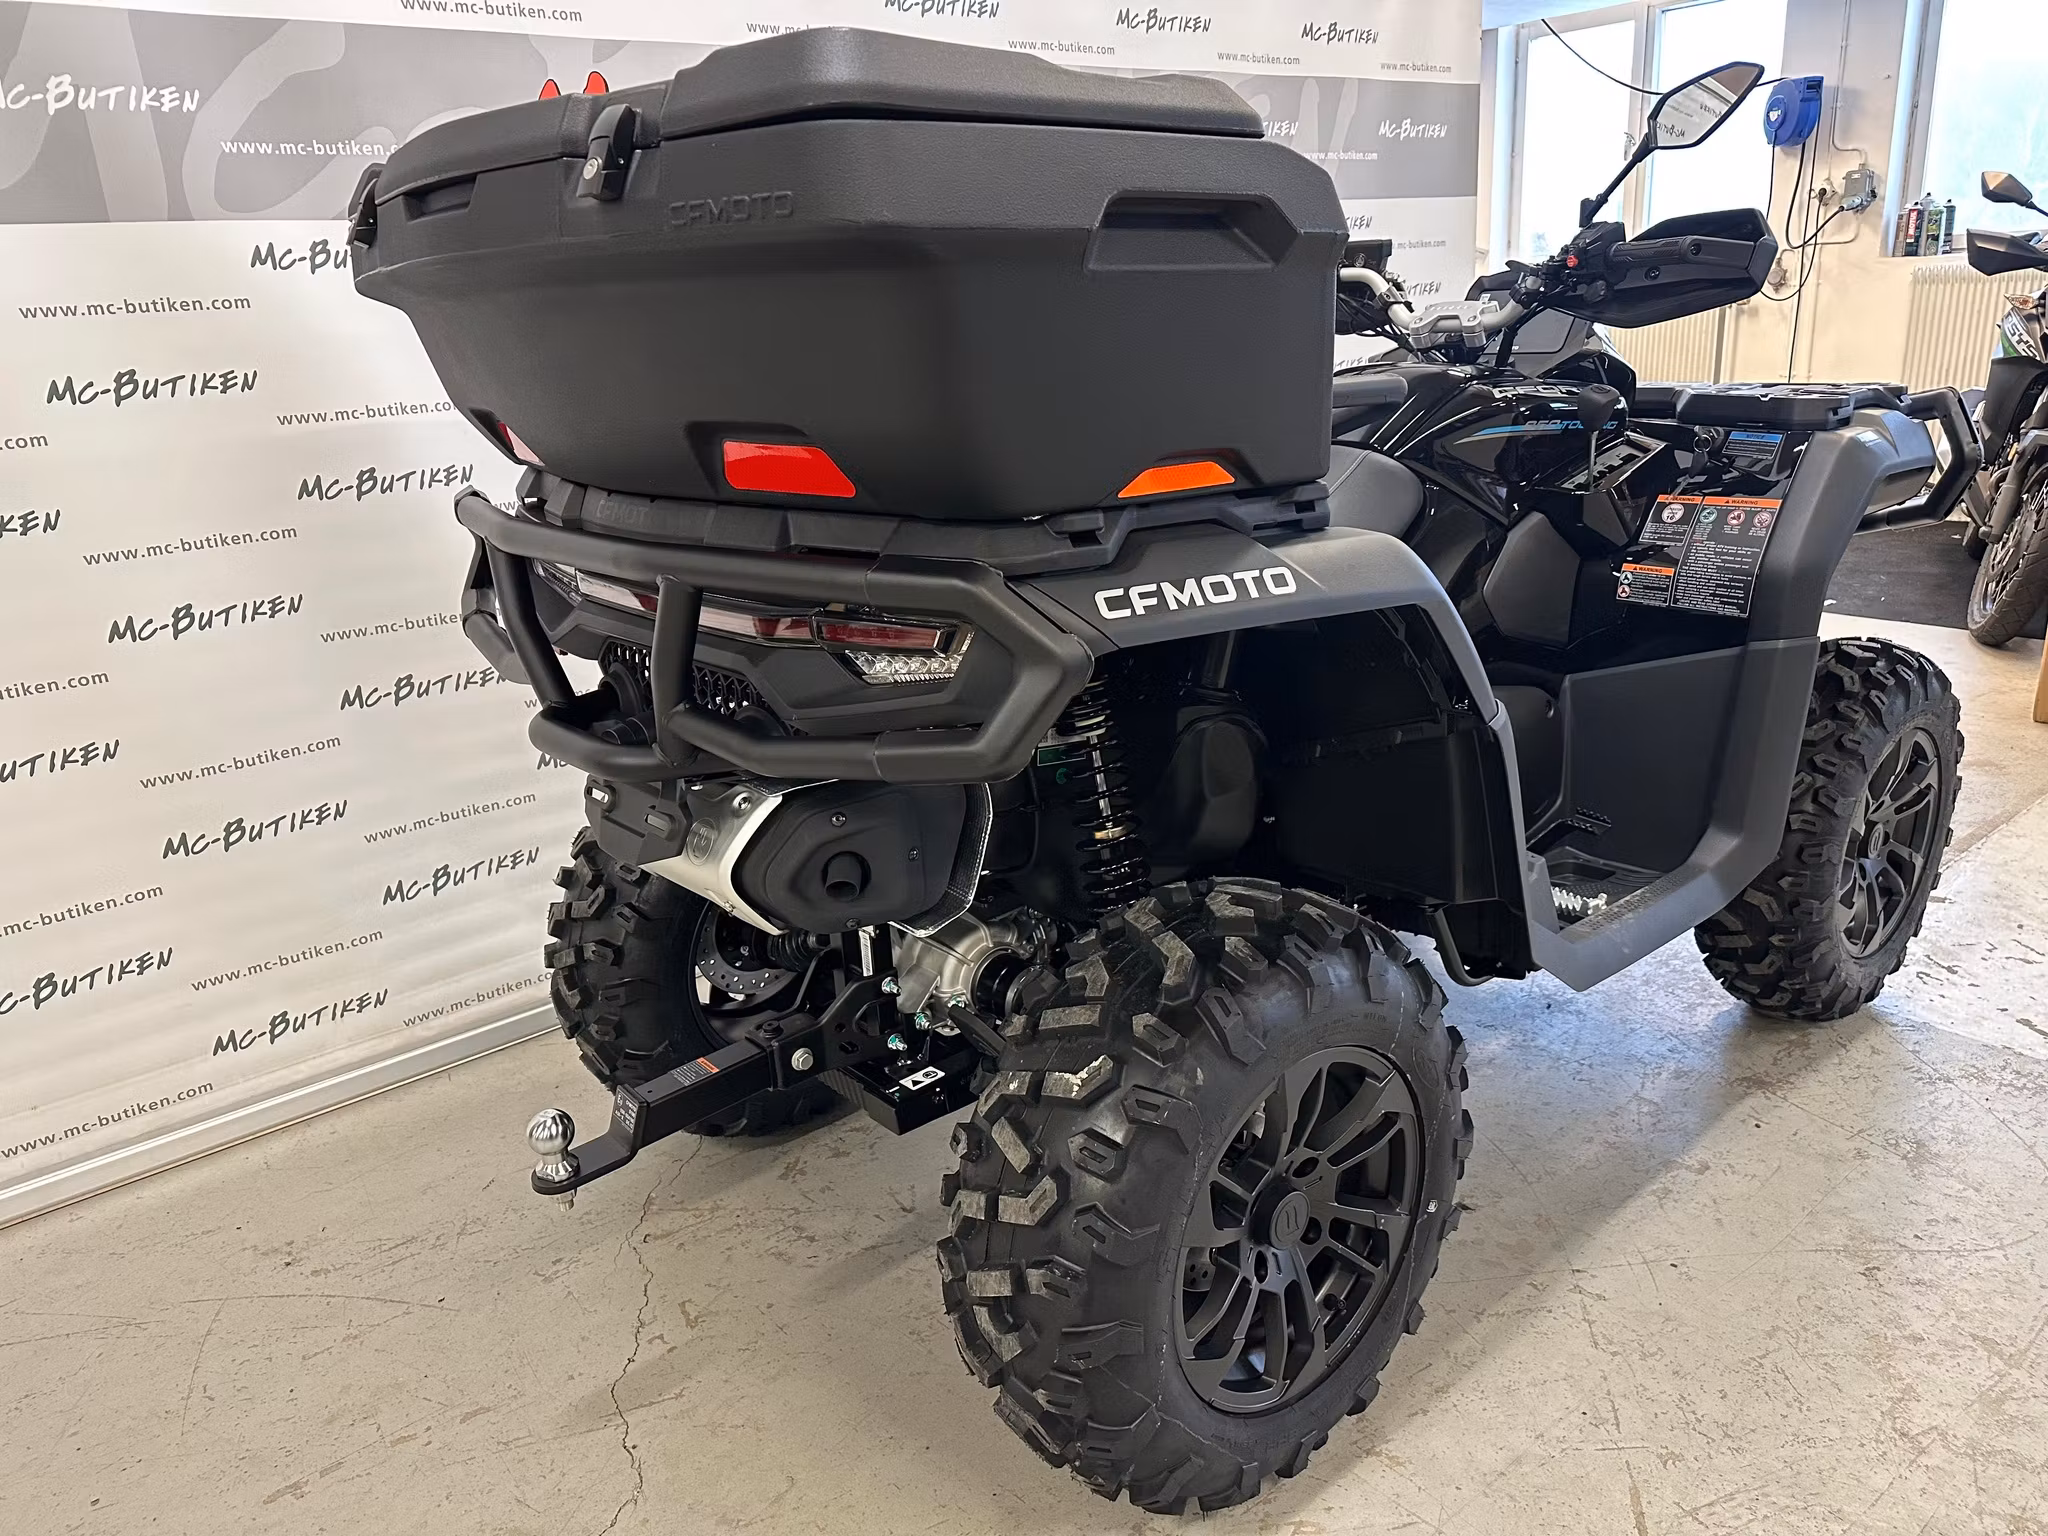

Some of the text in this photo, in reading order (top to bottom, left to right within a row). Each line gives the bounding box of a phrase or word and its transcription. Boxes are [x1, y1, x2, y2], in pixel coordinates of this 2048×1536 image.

[1007, 39, 1115, 55] www.mc-butiken.com
[1217, 52, 1300, 65] www.mc-butiken.com
[0, 73, 200, 116] C-BUTIKEN
[1908, 210, 1917, 237] MOTUL
[18, 296, 251, 319] www.mc-butiken.com
[82, 526, 298, 566] www.mc-butiken.com
[1094, 566, 1297, 620] CFMOTO
[320, 612, 463, 643] www.mc-butike
[139, 736, 341, 790] www.mc-butiken.com
[364, 792, 537, 844] www.mc-butiken.com
[190, 930, 384, 992] www.mc-butiken.com
[402, 971, 552, 1027] www.mc-butiken.co
[1, 1081, 214, 1159] www.mc-butiken.com
